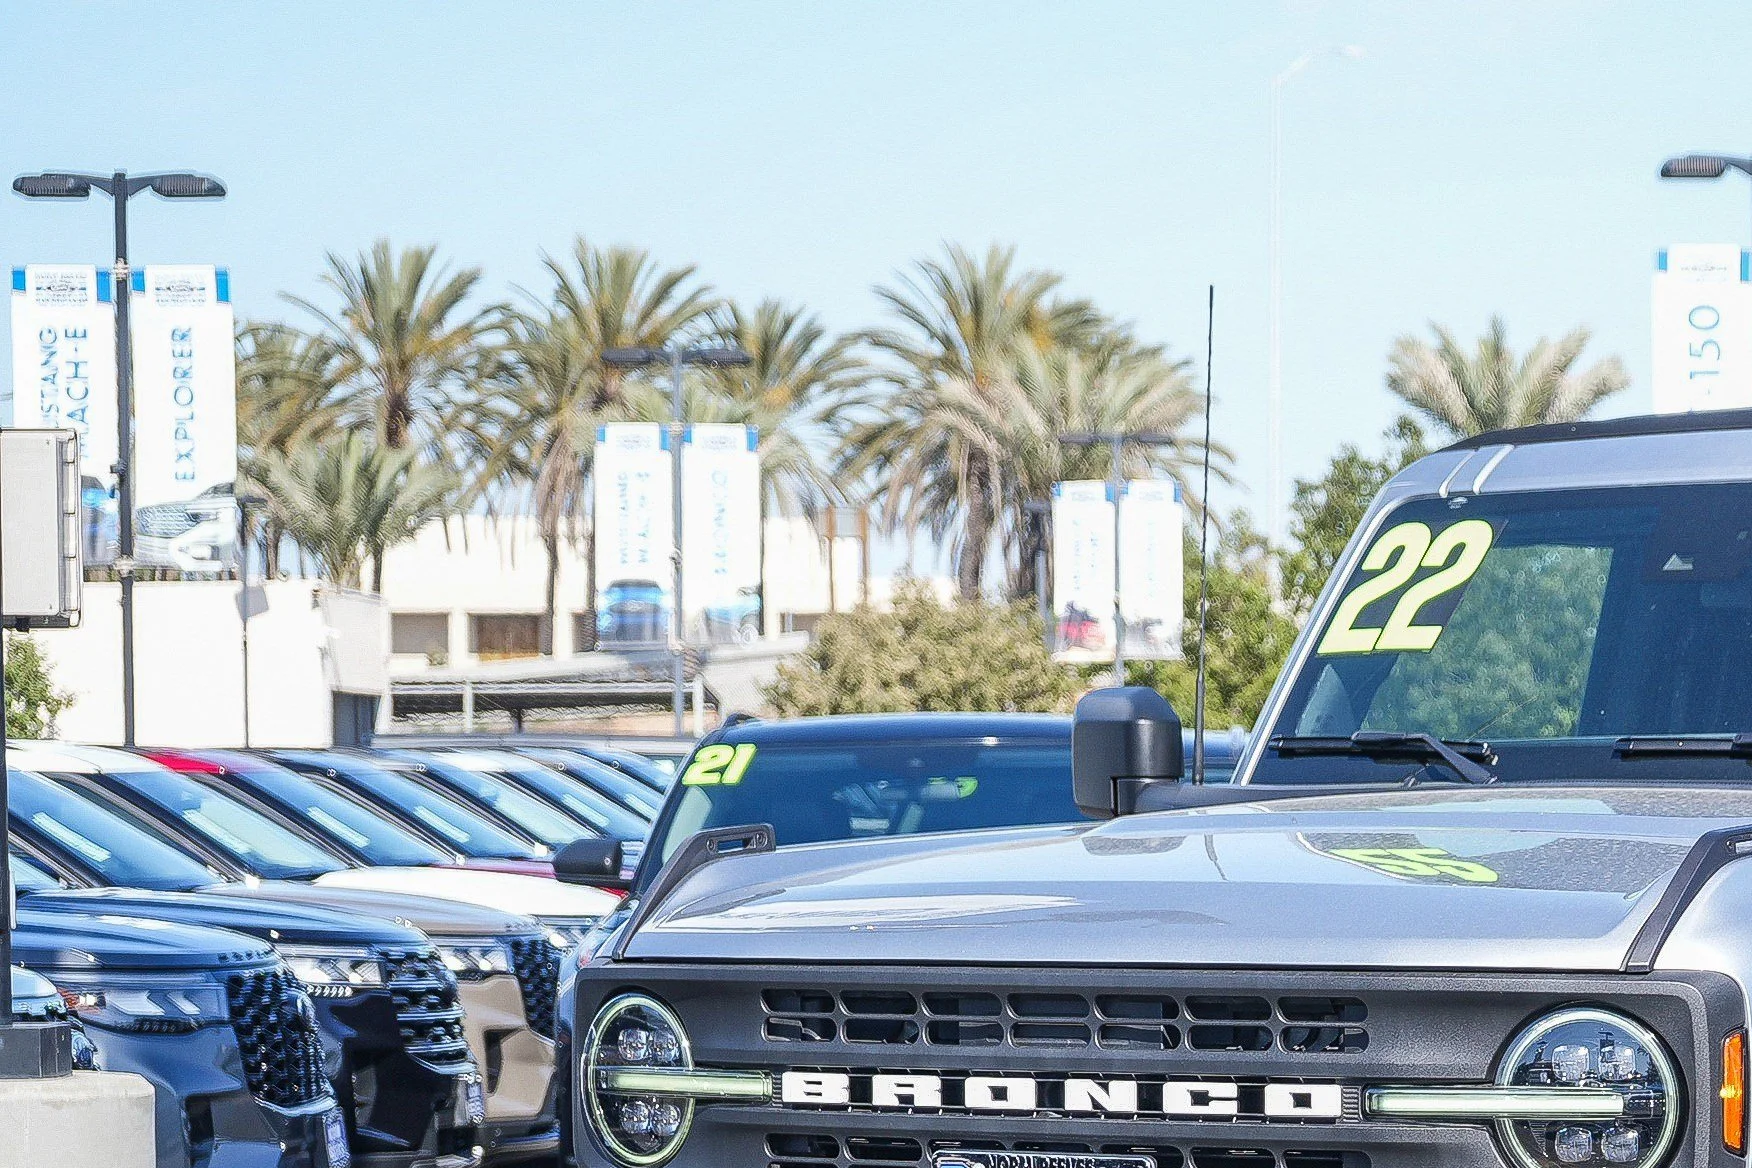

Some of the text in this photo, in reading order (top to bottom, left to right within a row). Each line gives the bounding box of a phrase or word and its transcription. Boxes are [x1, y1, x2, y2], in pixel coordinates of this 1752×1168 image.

[171, 327, 196, 481] EXPLORER
[1316, 518, 1495, 657] 22
[682, 743, 758, 787] 21
[781, 1070, 1344, 1119] BRONCO
